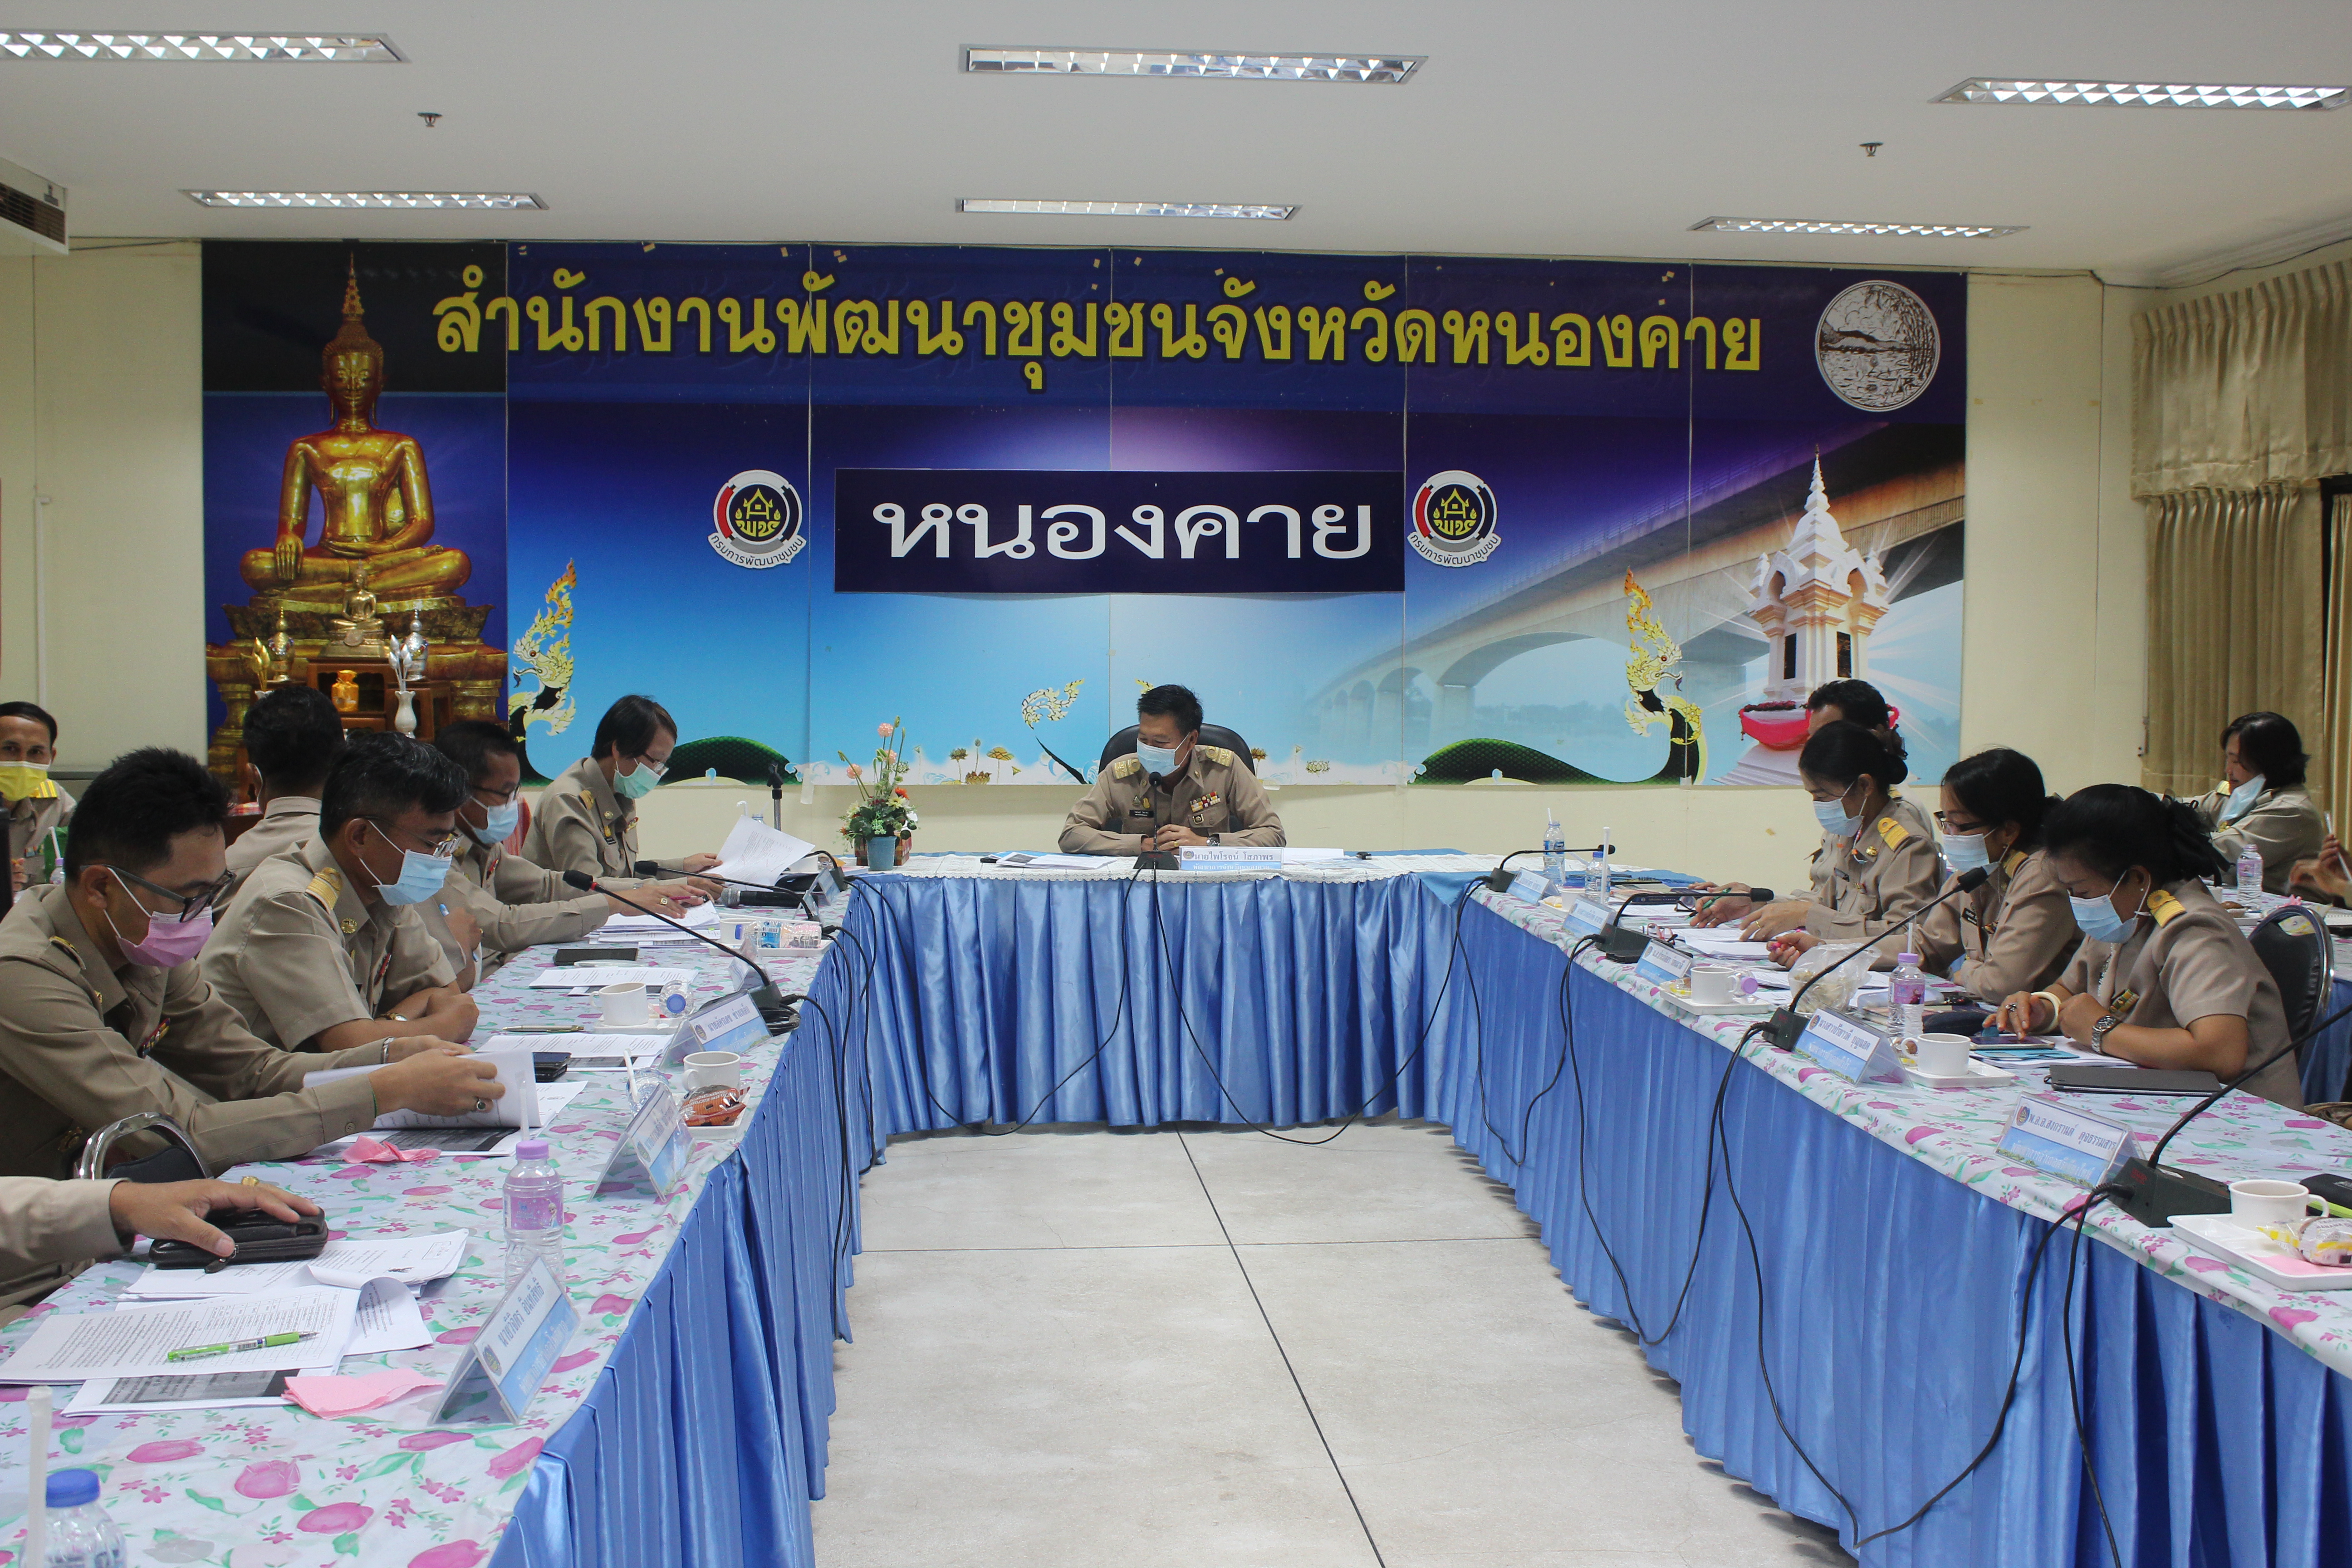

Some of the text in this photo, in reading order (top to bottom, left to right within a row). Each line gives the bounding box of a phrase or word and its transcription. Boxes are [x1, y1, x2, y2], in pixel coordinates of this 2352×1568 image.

[433, 265, 1761, 390] สำนักงานพัฒนาชุมชนจังหวัดหนองคาย
[872, 502, 1373, 560] หนองคาย
[711, 535, 804, 566] กรมการพัฒนาชุมชน
[1410, 534, 1499, 564] กรมการพัฒนาชุมชน
[1194, 851, 1273, 861] นายไพโรจน์ โสภาพร
